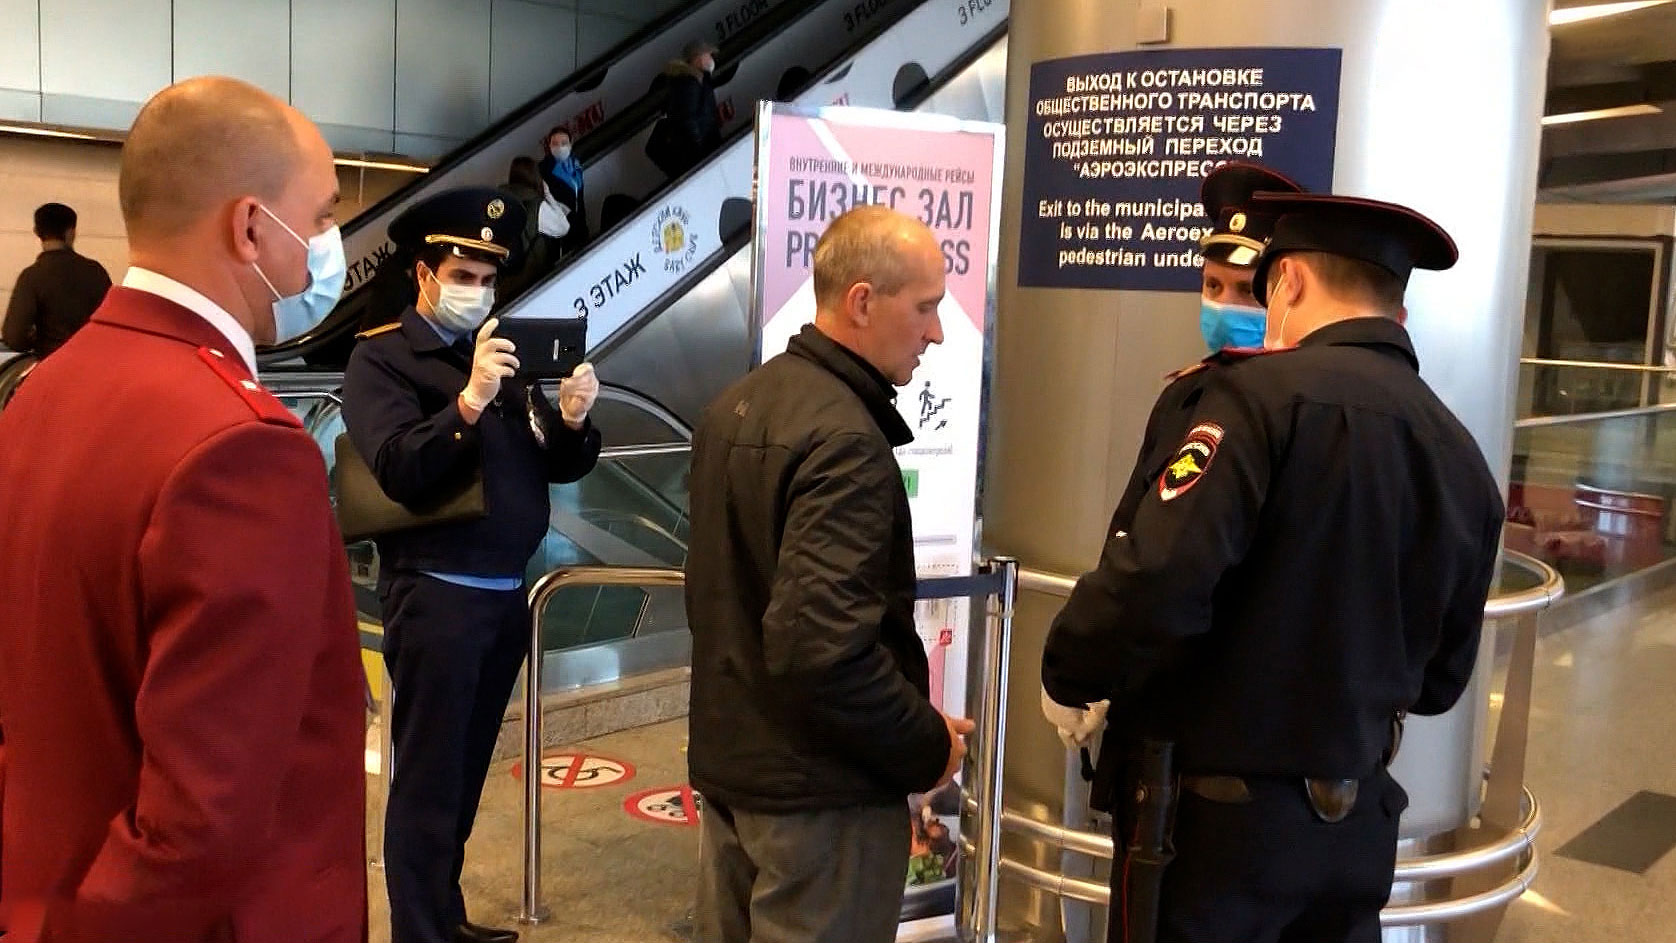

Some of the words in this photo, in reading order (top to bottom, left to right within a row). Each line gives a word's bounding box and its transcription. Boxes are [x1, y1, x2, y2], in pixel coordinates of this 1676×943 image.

[958, 6, 968, 25] 3
[1066, 74, 1122, 93] ВЫХОД
[1126, 72, 1137, 89] К
[1140, 68, 1264, 88] ОСТАНОВКЕ
[1036, 92, 1173, 116] ОБЩЕСТВЕННОГО
[1178, 92, 1316, 112] ТРАНСПОРТА
[1043, 115, 1204, 139] ОСУЩЕСТВЛЯЕТСЯ
[1213, 115, 1282, 134] ЧЕРЕЗ
[1053, 134, 1154, 159] ПОДЗЕМНЫЙ
[1165, 137, 1263, 157] ПЕРЕХОД
[789, 156, 848, 175] ВНУТРЕННИЕ
[860, 162, 942, 182] МЕЖДУНАРОДНЫЕ
[944, 166, 976, 184] РЕЙСЫ
[918, 187, 974, 231] ЗАЛ
[1038, 199, 1062, 218] Exit
[1066, 201, 1081, 217] to
[1084, 199, 1110, 217] the
[1114, 199, 1209, 221] municipa
[1076, 222, 1099, 239] via
[1104, 222, 1133, 239] the
[1140, 223, 1214, 241] Aeroex
[1058, 248, 1147, 268] pedestrian
[1153, 247, 1205, 267] unde
[573, 297, 589, 320] 3
[590, 252, 647, 309] ЭТАЖ
